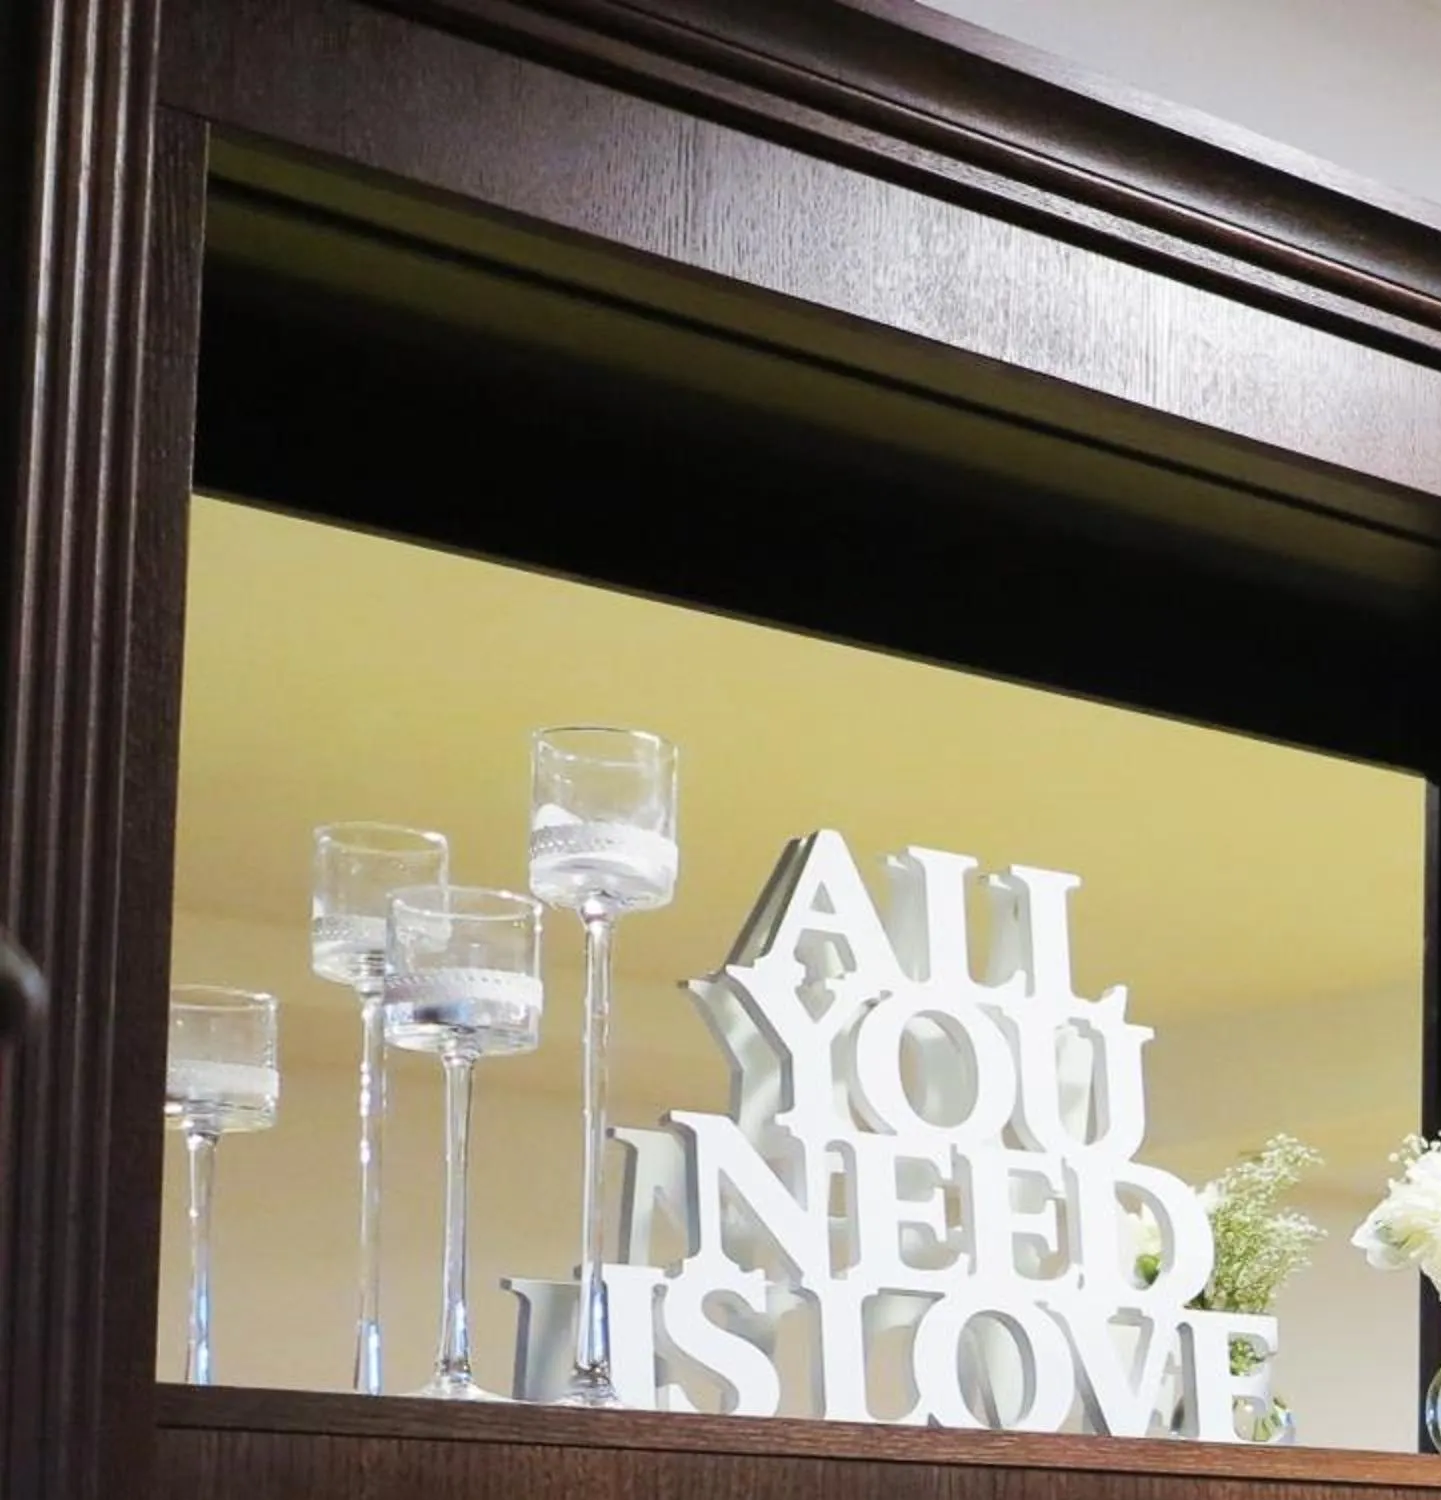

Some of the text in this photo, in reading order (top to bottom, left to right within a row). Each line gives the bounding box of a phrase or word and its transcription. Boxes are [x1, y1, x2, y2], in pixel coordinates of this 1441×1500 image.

[752, 829, 1128, 1018] ALL
[727, 968, 1154, 1158] YOU
[668, 1111, 1214, 1307] NEED
[595, 1264, 1278, 1442] IS LOVE
